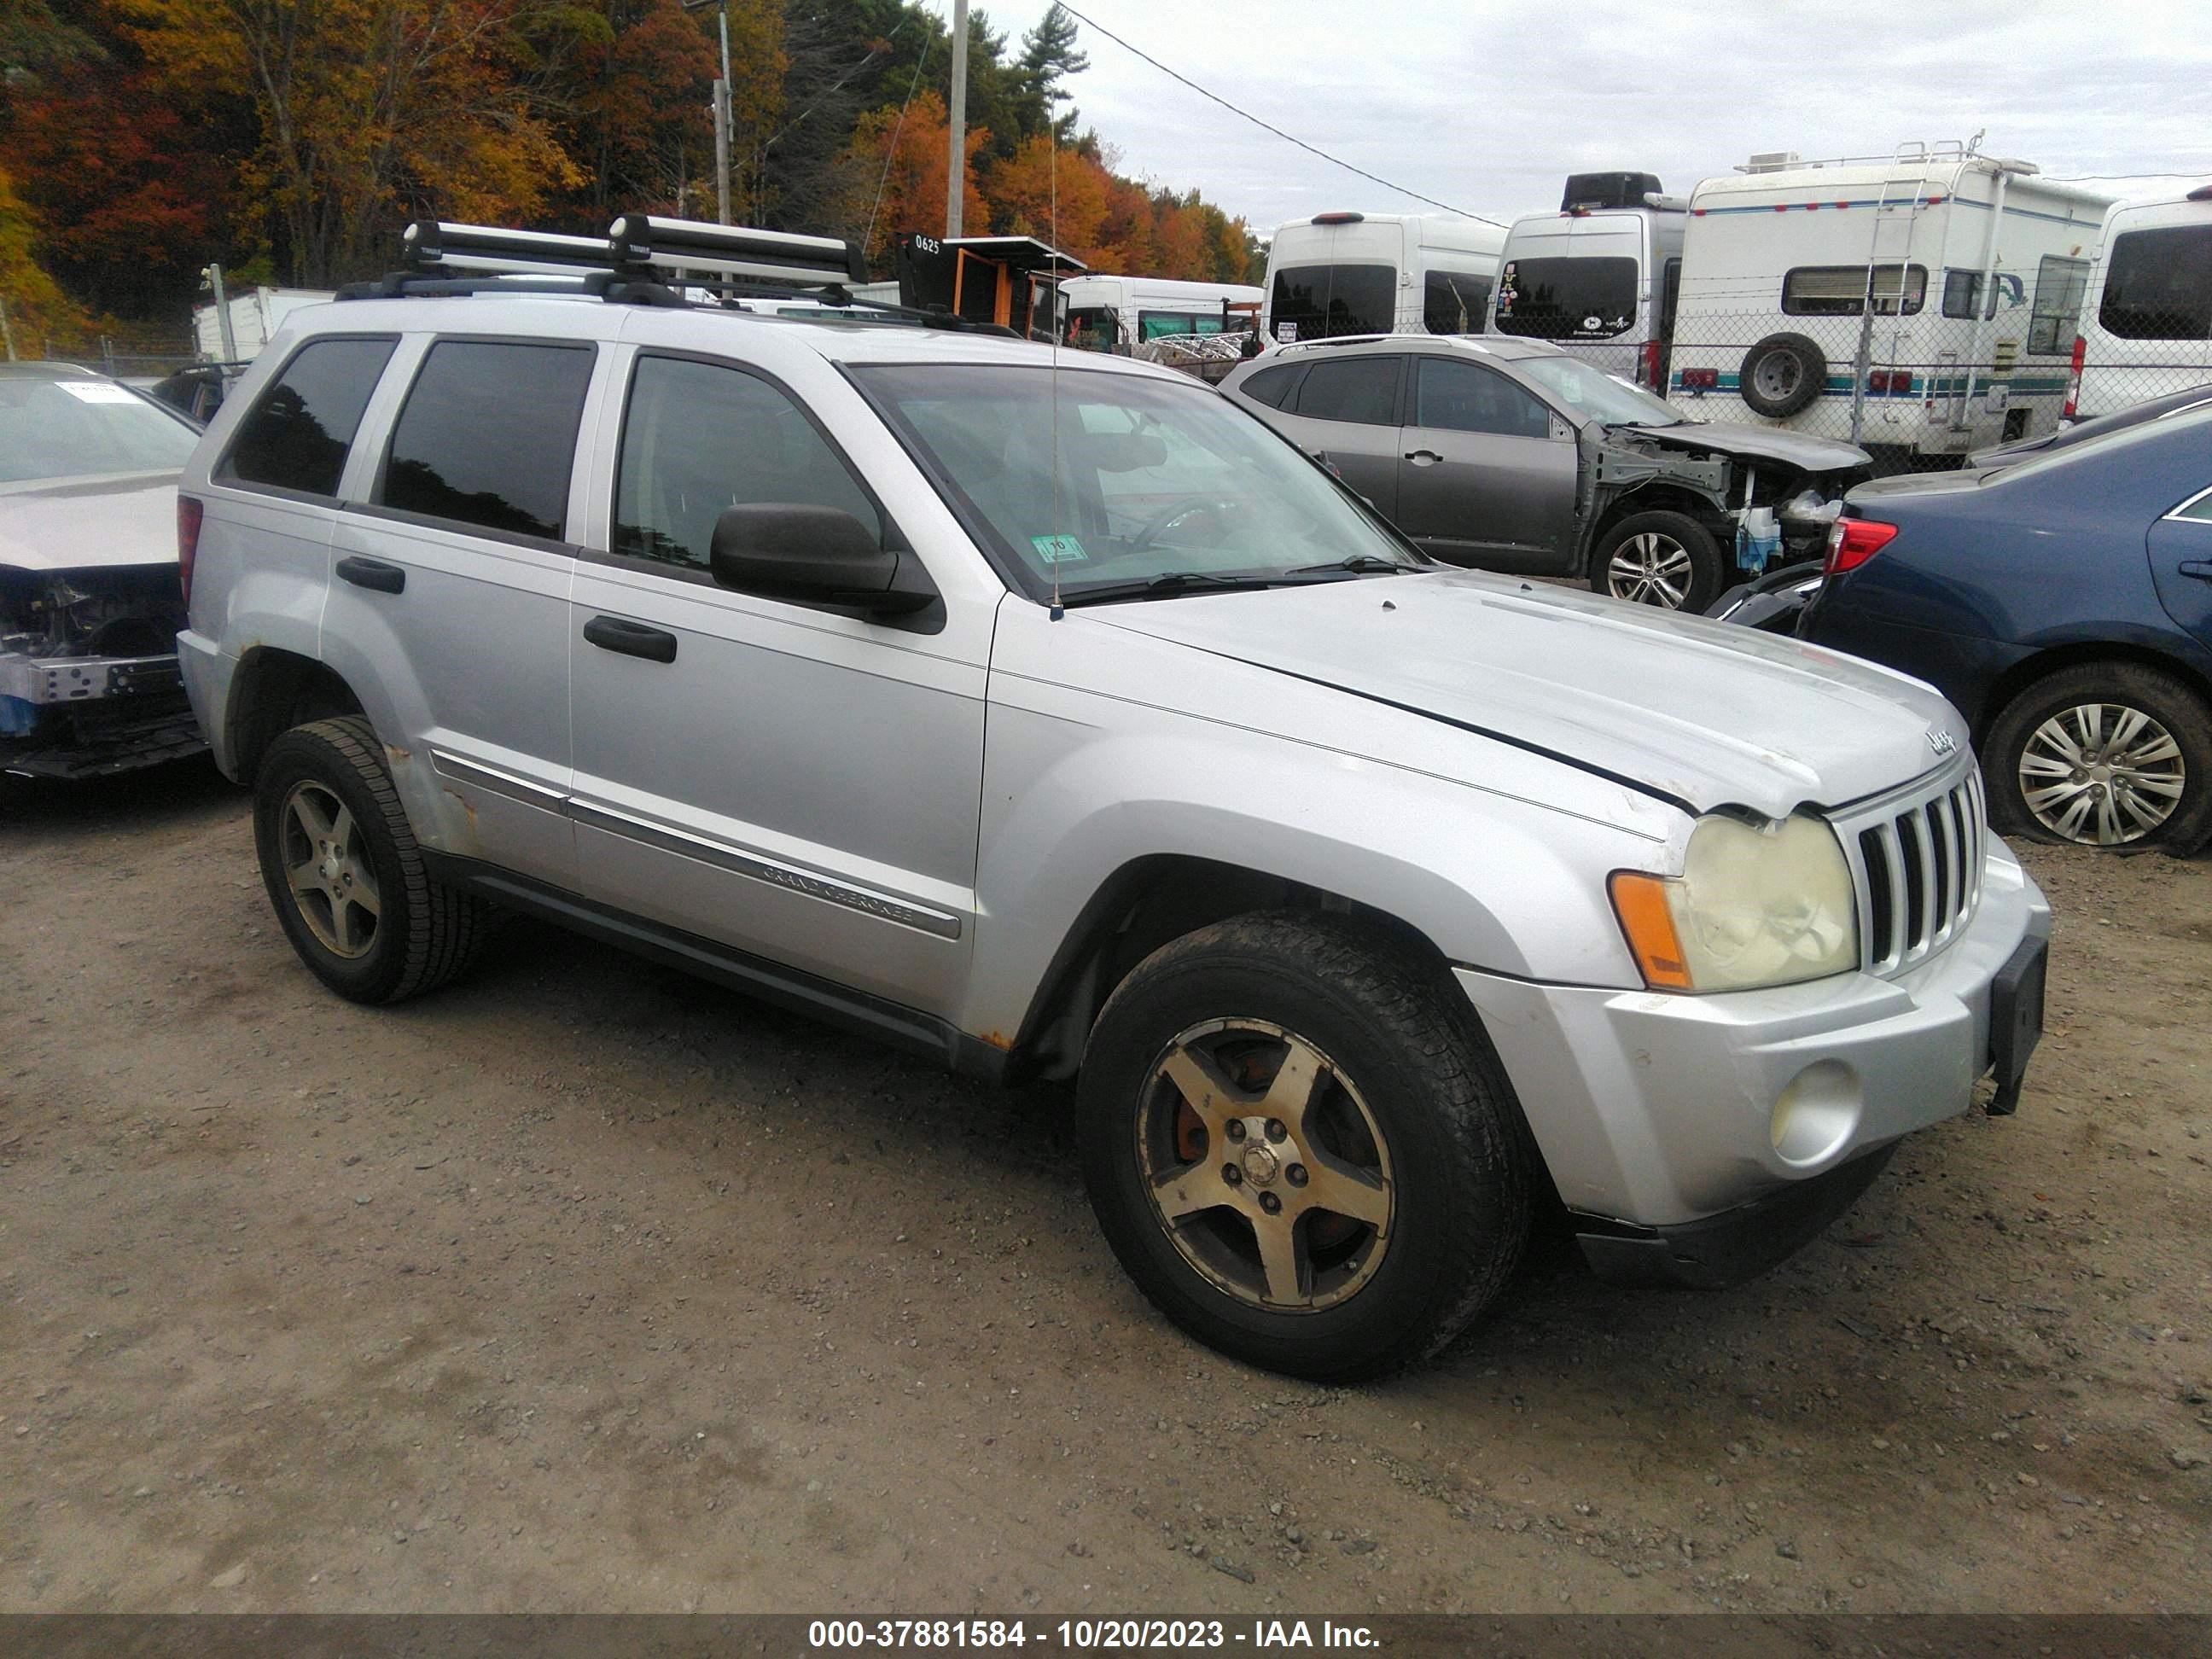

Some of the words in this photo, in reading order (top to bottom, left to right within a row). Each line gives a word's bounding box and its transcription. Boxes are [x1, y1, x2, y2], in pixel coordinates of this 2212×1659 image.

[916, 235, 940, 254] 0625
[1925, 731, 1958, 756] Jeep
[764, 867, 819, 893] GRAND
